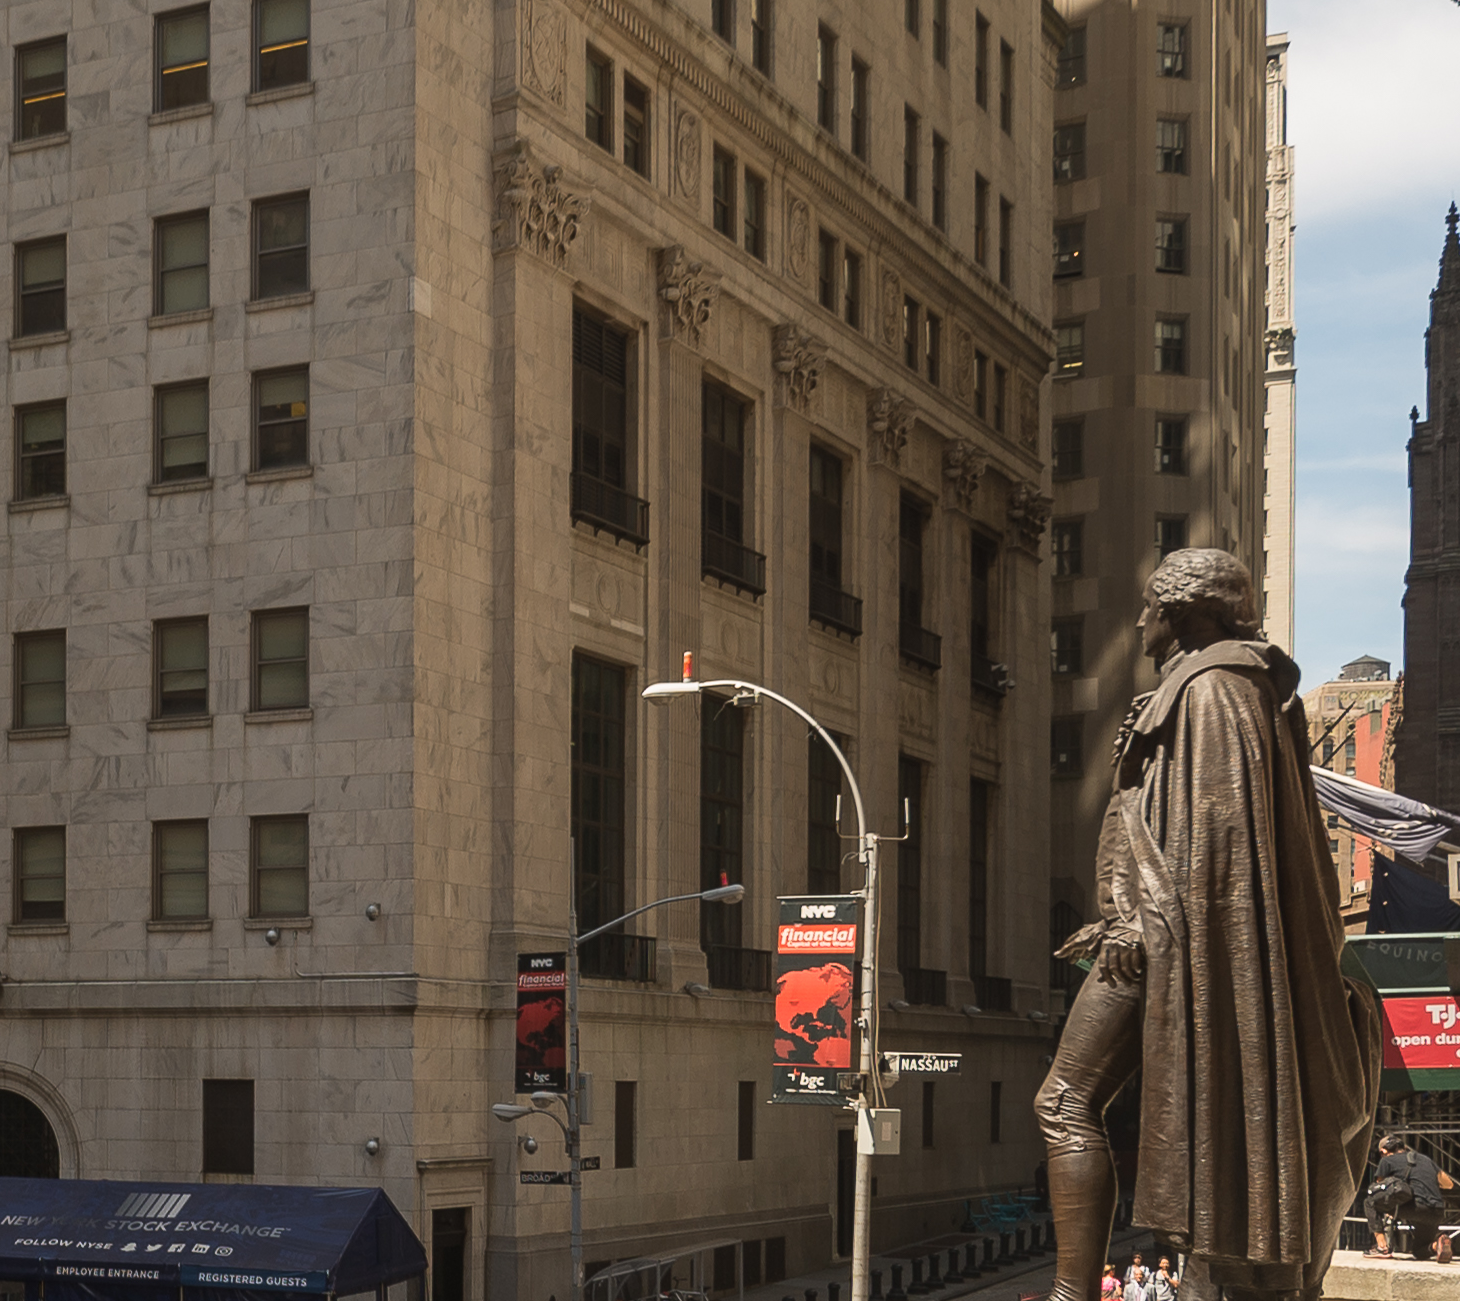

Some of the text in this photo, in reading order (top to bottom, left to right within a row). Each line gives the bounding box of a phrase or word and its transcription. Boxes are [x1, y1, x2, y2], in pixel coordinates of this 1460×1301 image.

[800, 905, 836, 919] NYC
[781, 928, 854, 945] financial
[1367, 940, 1445, 963] EQUINO
[531, 959, 553, 968] NYC
[519, 973, 564, 986] financial
[1391, 1034, 1431, 1048] open
[901, 1058, 958, 1072] NASSAU ST
[800, 1072, 825, 1089] bgc
[521, 1173, 551, 1182] BROAD
[0, 1215, 44, 1227] NEW
[104, 1219, 171, 1232] STOCK
[14, 1238, 114, 1250] FOLLOW NYSE
[56, 1266, 160, 1279] EMPLOYEE ENTRANCE
[198, 1272, 307, 1288] REGISTERED GUESTS
